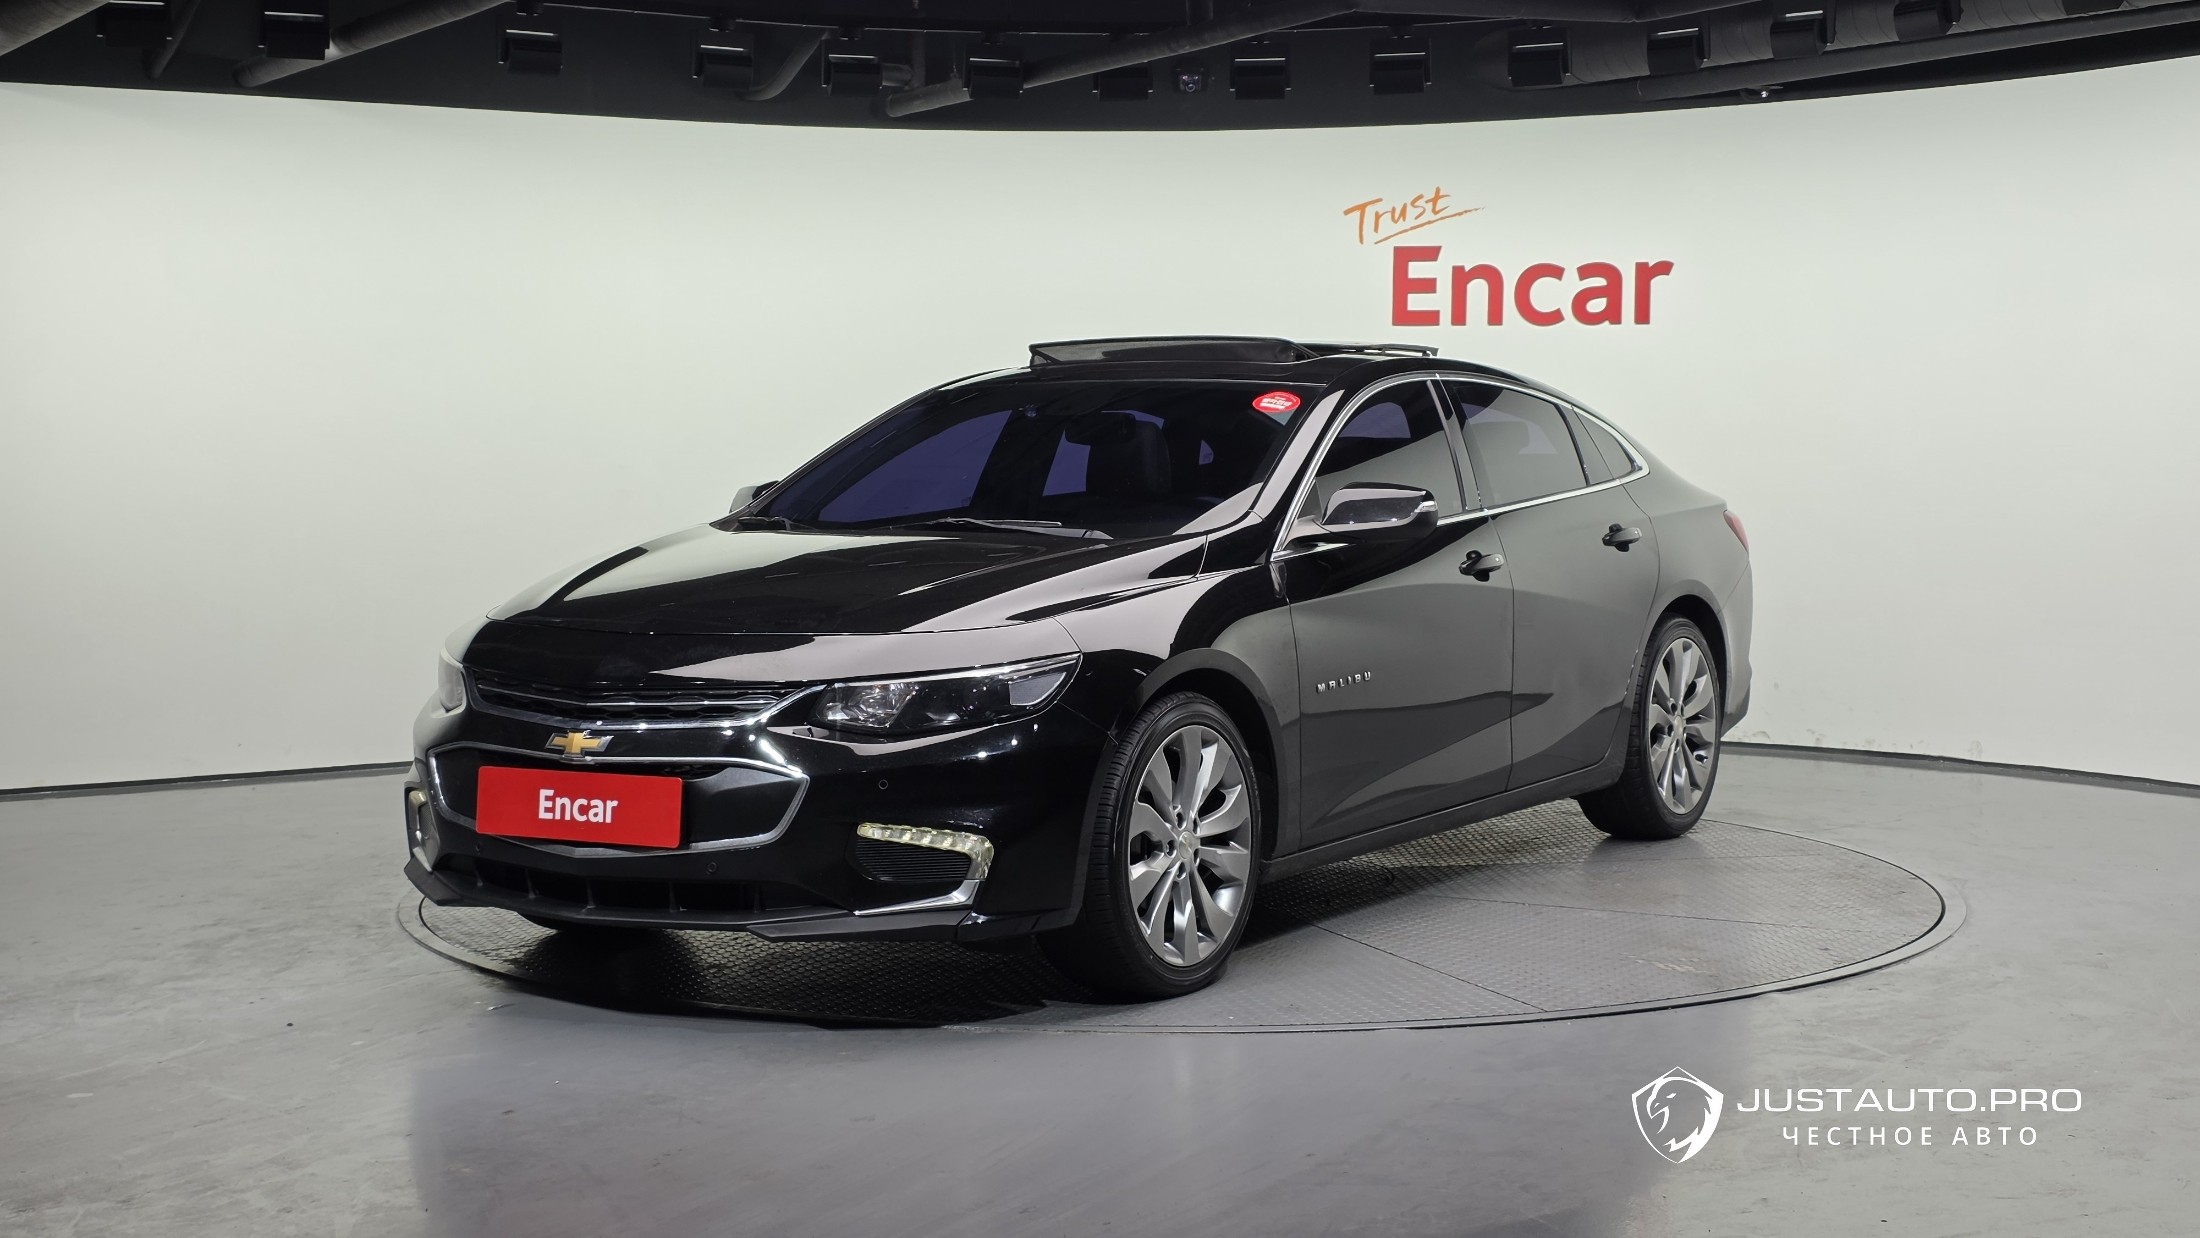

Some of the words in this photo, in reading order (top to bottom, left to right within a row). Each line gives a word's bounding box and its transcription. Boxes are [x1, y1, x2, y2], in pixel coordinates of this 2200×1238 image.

[1343, 186, 1453, 246] Trust
[1391, 245, 1674, 327] Encar
[1316, 671, 1371, 693] MALIBU
[538, 788, 619, 823] Encar
